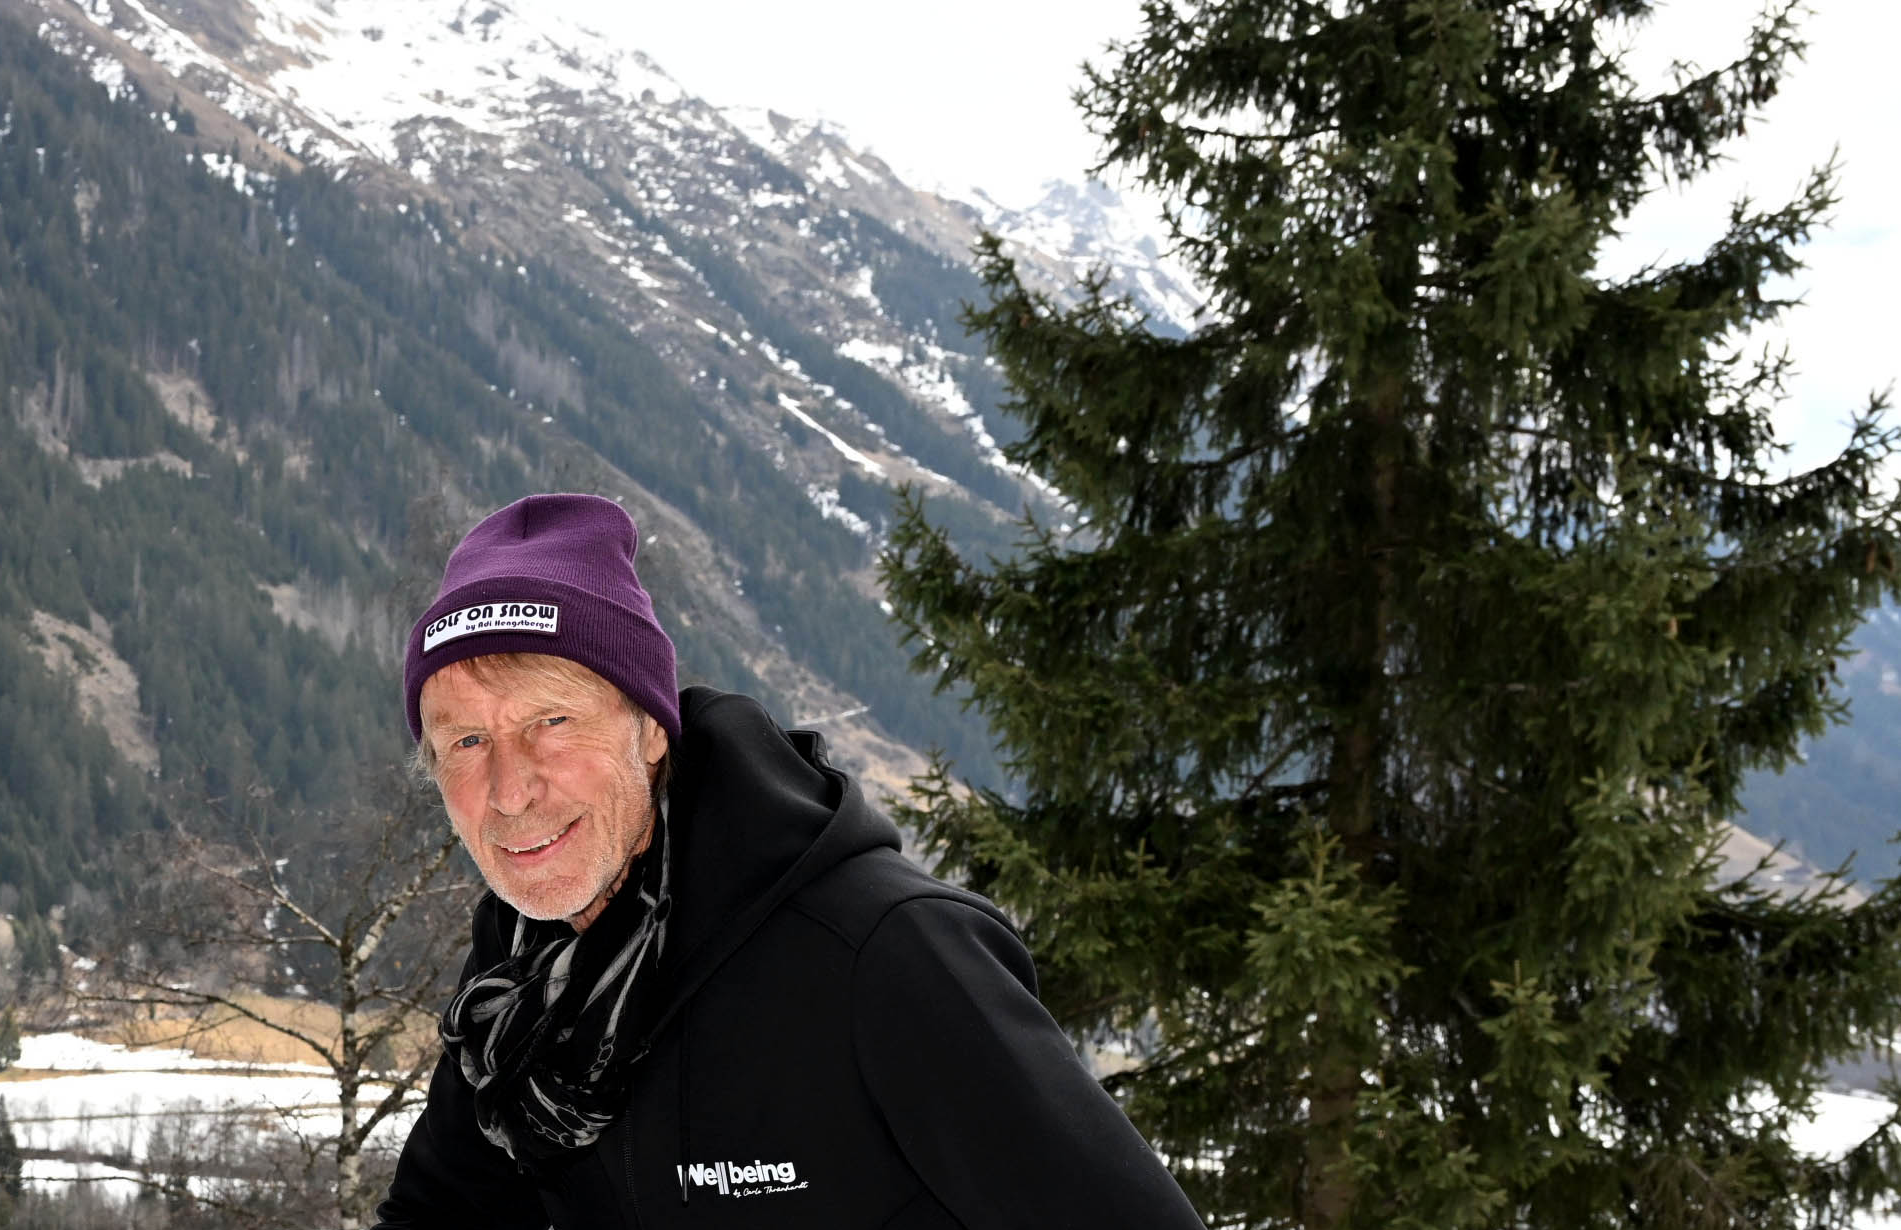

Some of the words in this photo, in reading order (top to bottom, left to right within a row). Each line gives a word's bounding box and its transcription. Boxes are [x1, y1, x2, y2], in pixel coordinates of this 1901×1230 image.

[427, 612, 462, 638] GOLF
[467, 605, 493, 620] ON
[499, 604, 555, 620] SNOW
[478, 621, 492, 629] Adi
[495, 619, 554, 629] Hengstberger
